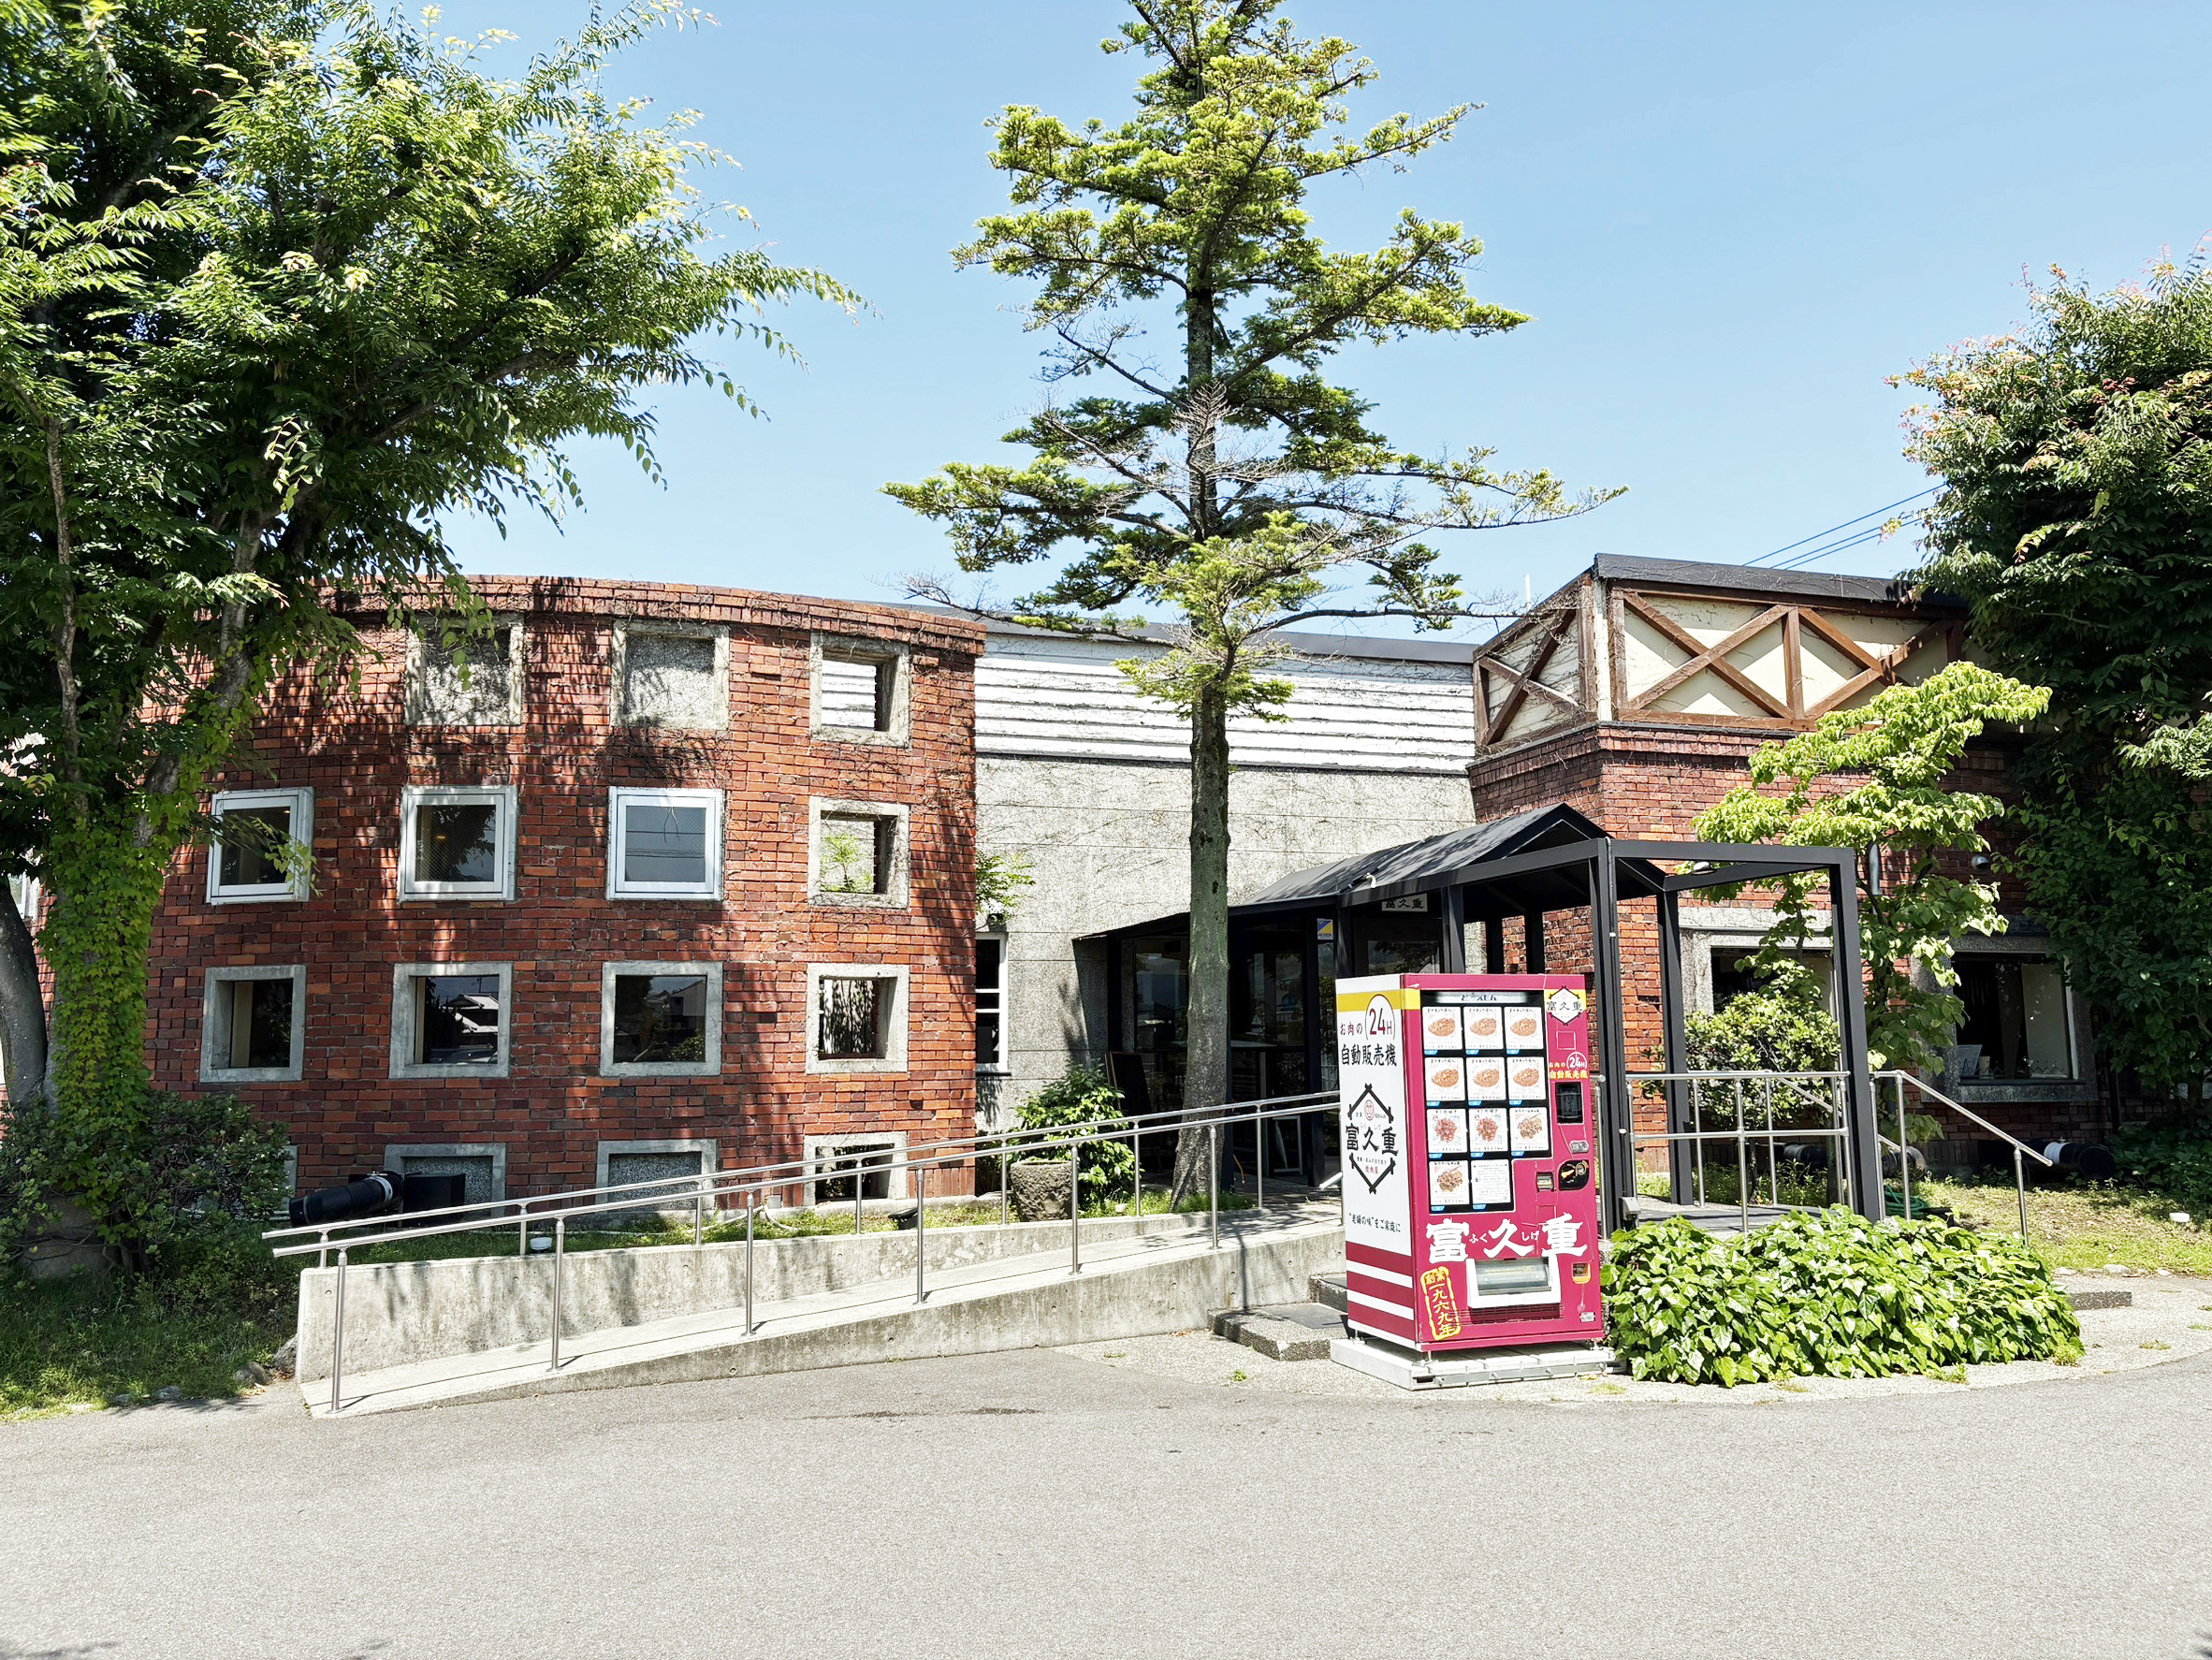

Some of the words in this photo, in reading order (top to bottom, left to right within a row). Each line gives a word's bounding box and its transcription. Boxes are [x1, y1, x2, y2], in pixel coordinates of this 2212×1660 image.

[1547, 1001, 1582, 1012] 富久重
[1340, 1021, 1363, 1036] お肉の
[1369, 1007, 1392, 1035] 24H
[1341, 1043, 1397, 1067] 自動販売機
[1569, 1056, 1586, 1068] 24H
[1550, 1070, 1589, 1079] 自動販売機
[1346, 1123, 1399, 1157] 富久重
[1426, 1213, 1588, 1263] 富久重
[1469, 1233, 1488, 1245] ふく
[1521, 1230, 1539, 1241] しげ
